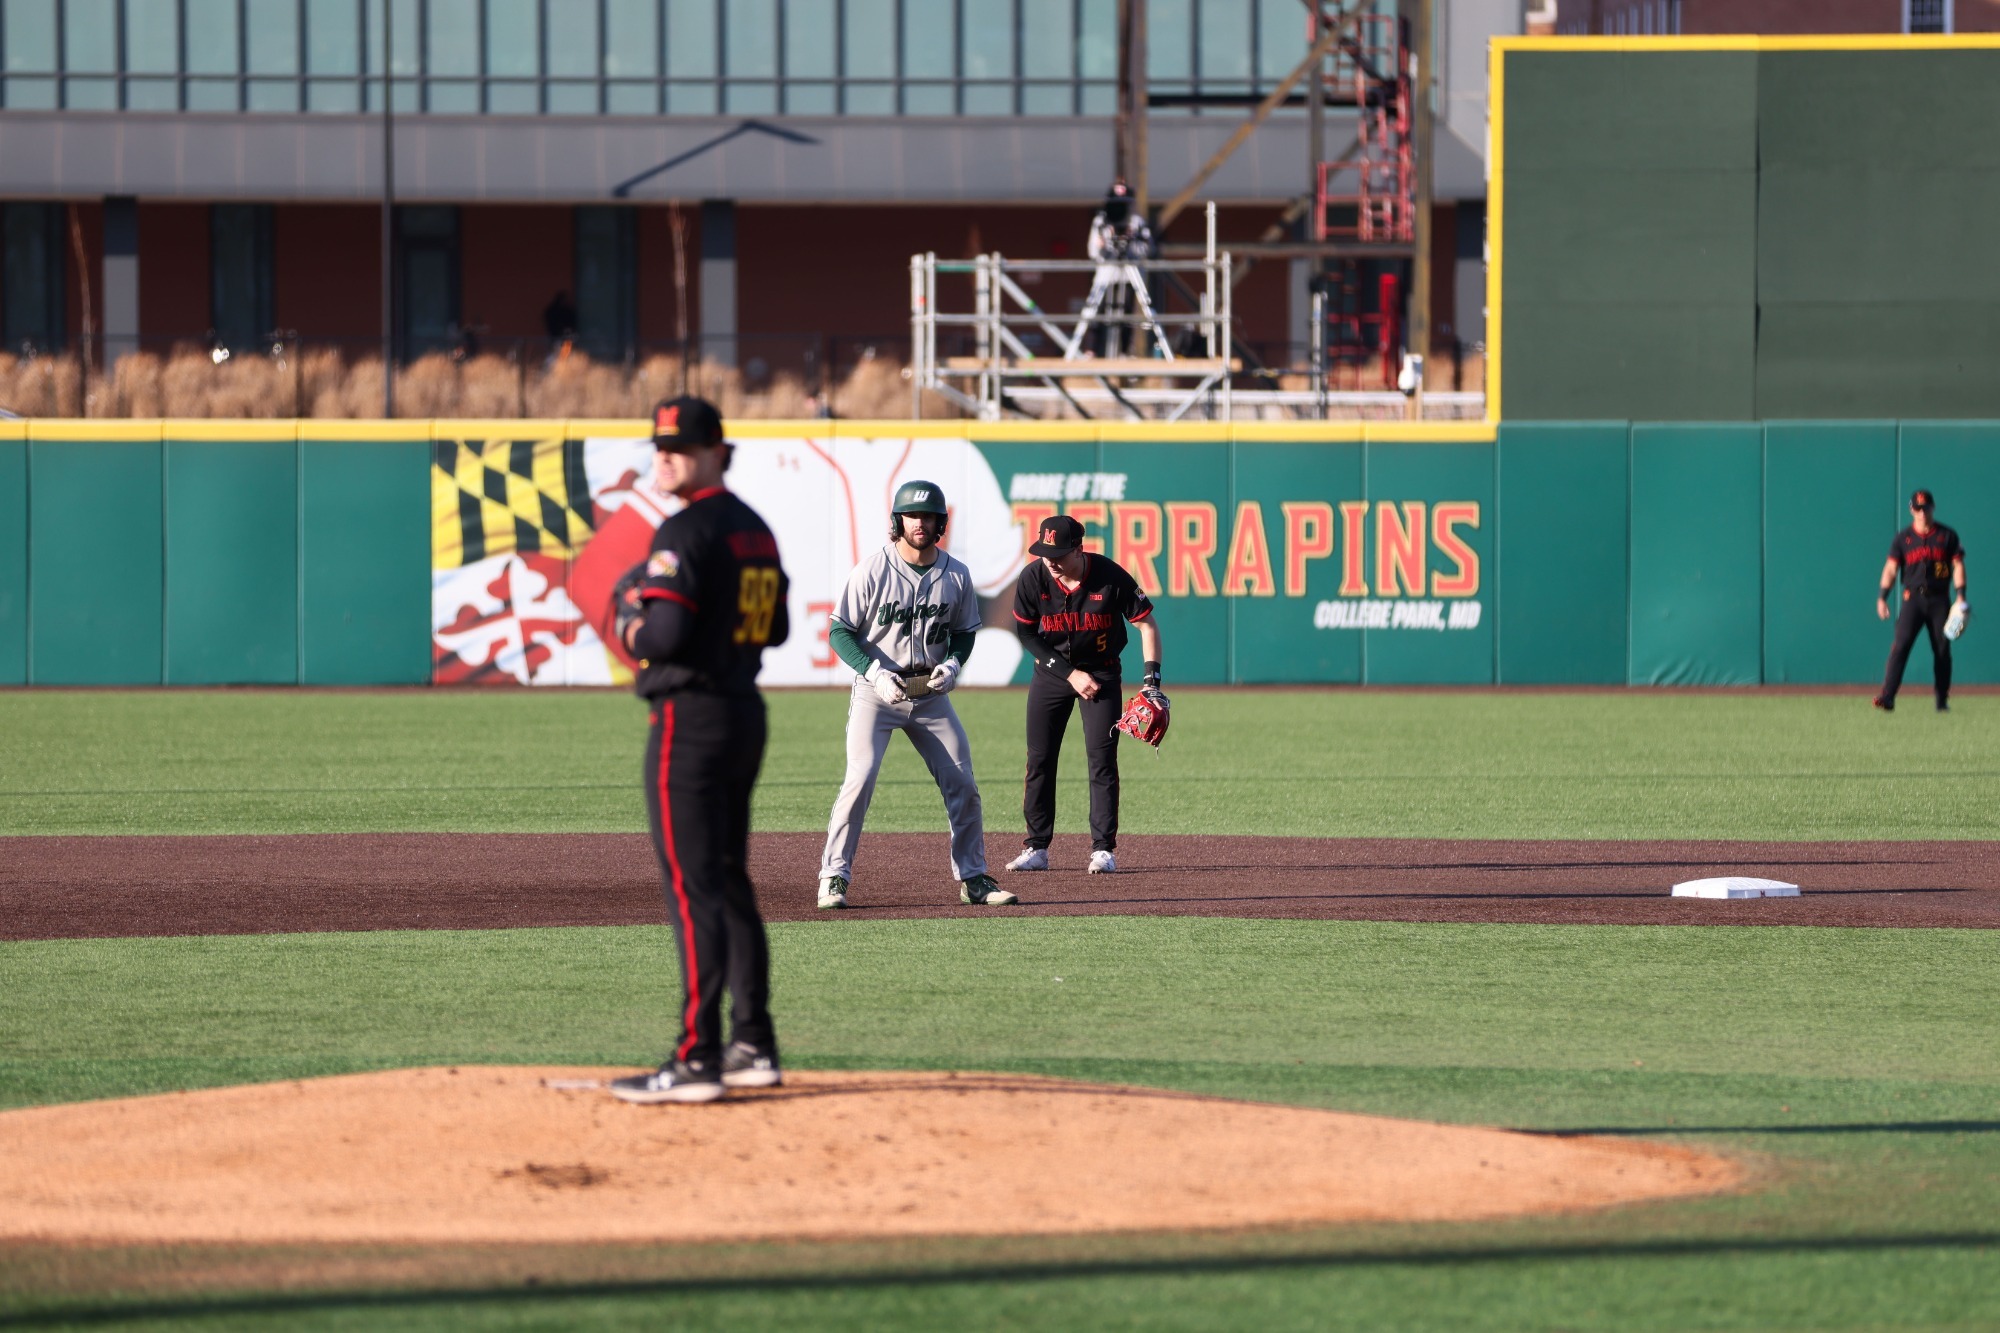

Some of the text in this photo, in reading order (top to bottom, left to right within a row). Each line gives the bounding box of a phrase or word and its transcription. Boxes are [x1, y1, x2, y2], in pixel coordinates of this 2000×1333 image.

[914, 490, 930, 502] W
[1065, 473, 1092, 500] OF
[1043, 528, 1056, 545] M
[733, 567, 779, 644] 98
[1314, 601, 1481, 632] COLLEGE PARK, MD
[877, 601, 950, 636] Wagner
[1041, 611, 1112, 632] MARYLAND
[1096, 633, 1107, 652] 5
